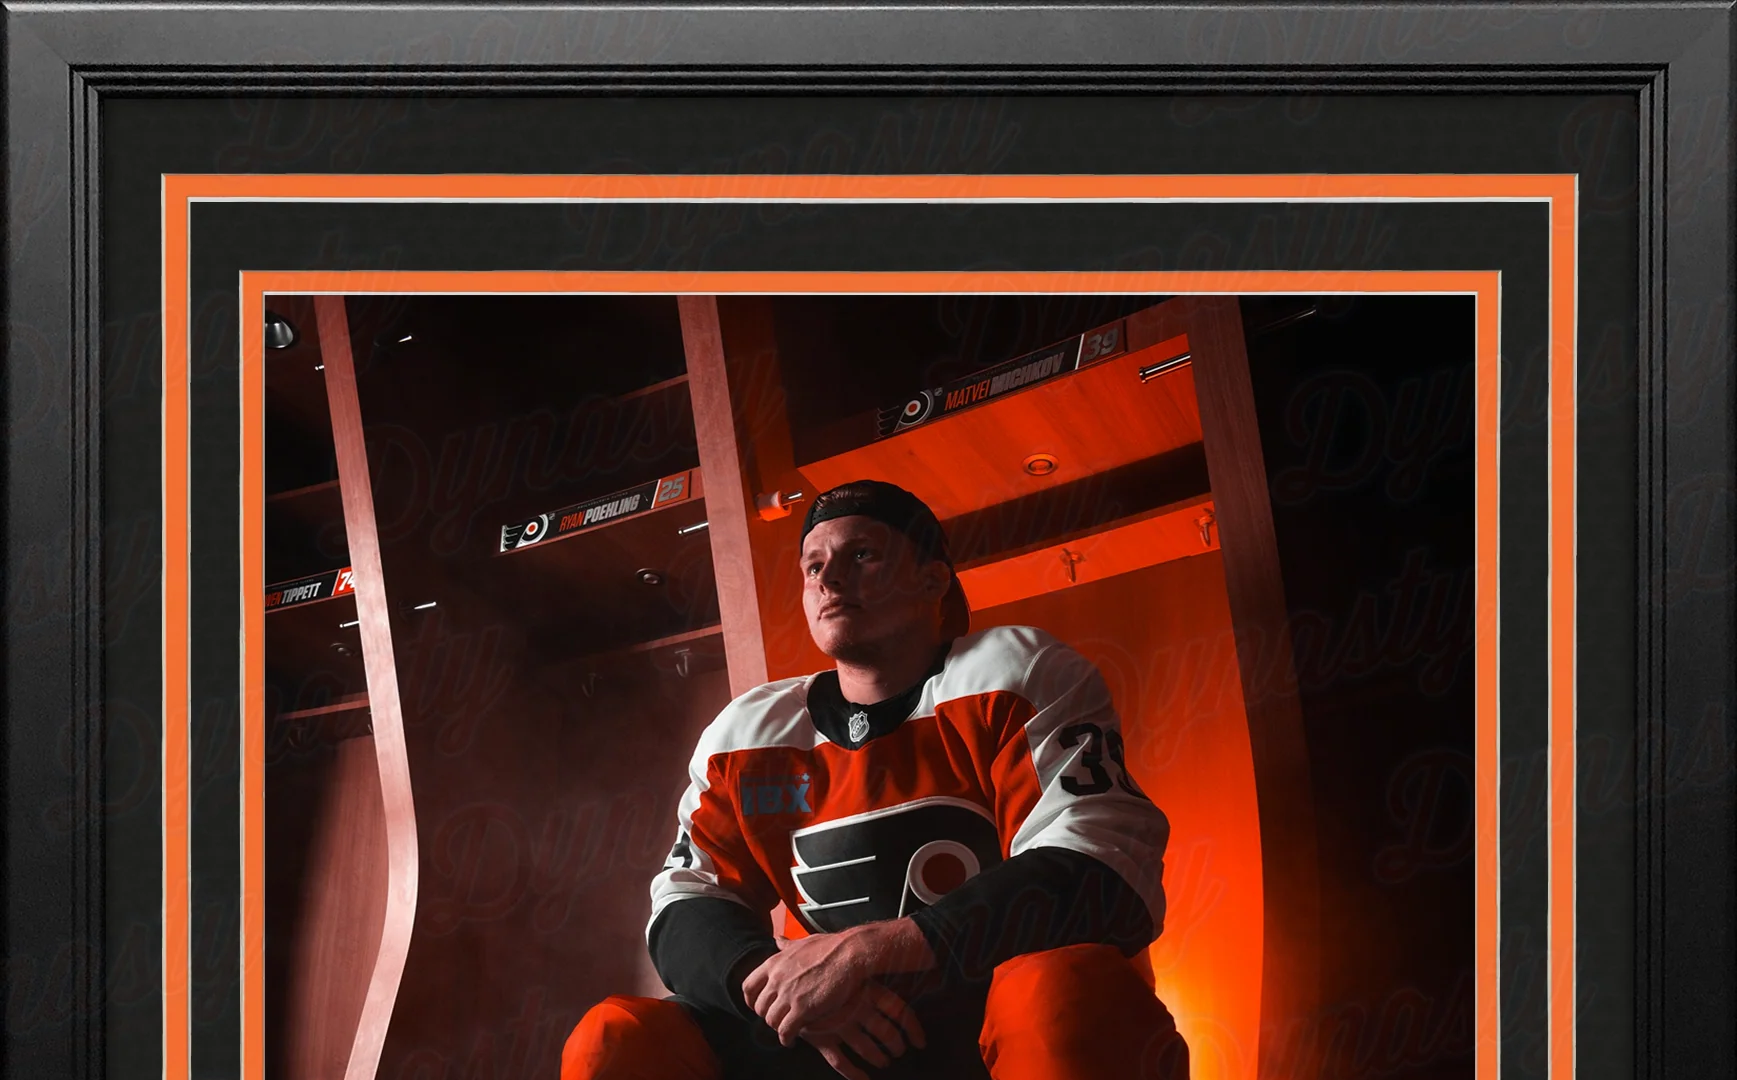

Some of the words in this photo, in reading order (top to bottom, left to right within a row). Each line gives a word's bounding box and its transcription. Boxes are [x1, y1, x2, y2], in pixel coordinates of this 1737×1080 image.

[943, 379, 991, 411] MATVEI
[989, 352, 1065, 397] MICHKOV
[1083, 327, 1119, 361] 39
[558, 511, 585, 533] RYAN
[583, 493, 641, 526] POEHLING
[657, 476, 685, 503] 25
[281, 582, 321, 604] TIPPETT
[741, 783, 812, 816] IBX
